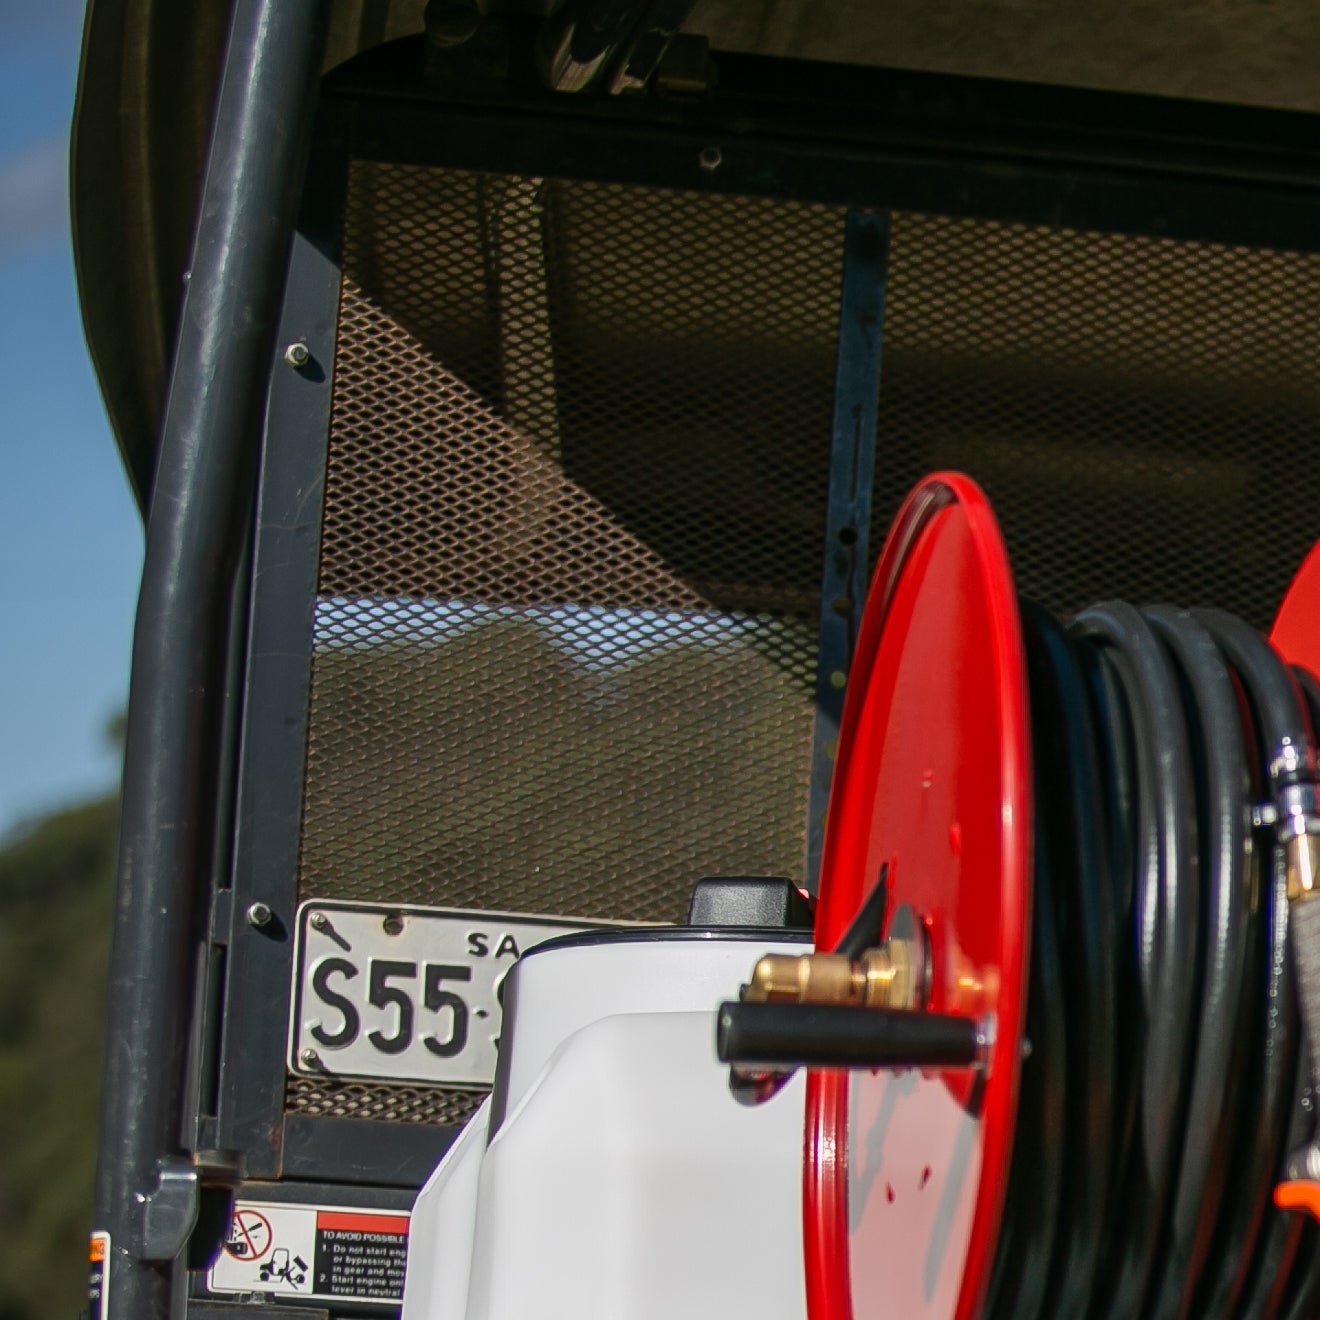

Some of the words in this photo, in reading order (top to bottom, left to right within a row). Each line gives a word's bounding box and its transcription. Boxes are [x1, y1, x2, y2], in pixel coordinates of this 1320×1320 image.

[467, 932, 520, 959] SA
[323, 1230, 334, 1239] TO
[336, 1231, 362, 1241] AVOID
[363, 1233, 404, 1243] POSSIBLE
[333, 1244, 346, 1252] Do
[348, 1245, 363, 1254] not
[366, 1247, 387, 1256] start
[333, 1256, 343, 1264] or
[345, 1256, 391, 1267] bypassing
[344, 1266, 365, 1275] gear
[367, 1267, 384, 1276] and
[331, 1275, 354, 1284] Start
[356, 1277, 387, 1287] engine
[331, 1285, 354, 1294] lever
[356, 1286, 365, 1294] in
[368, 1288, 400, 1297] neutral
